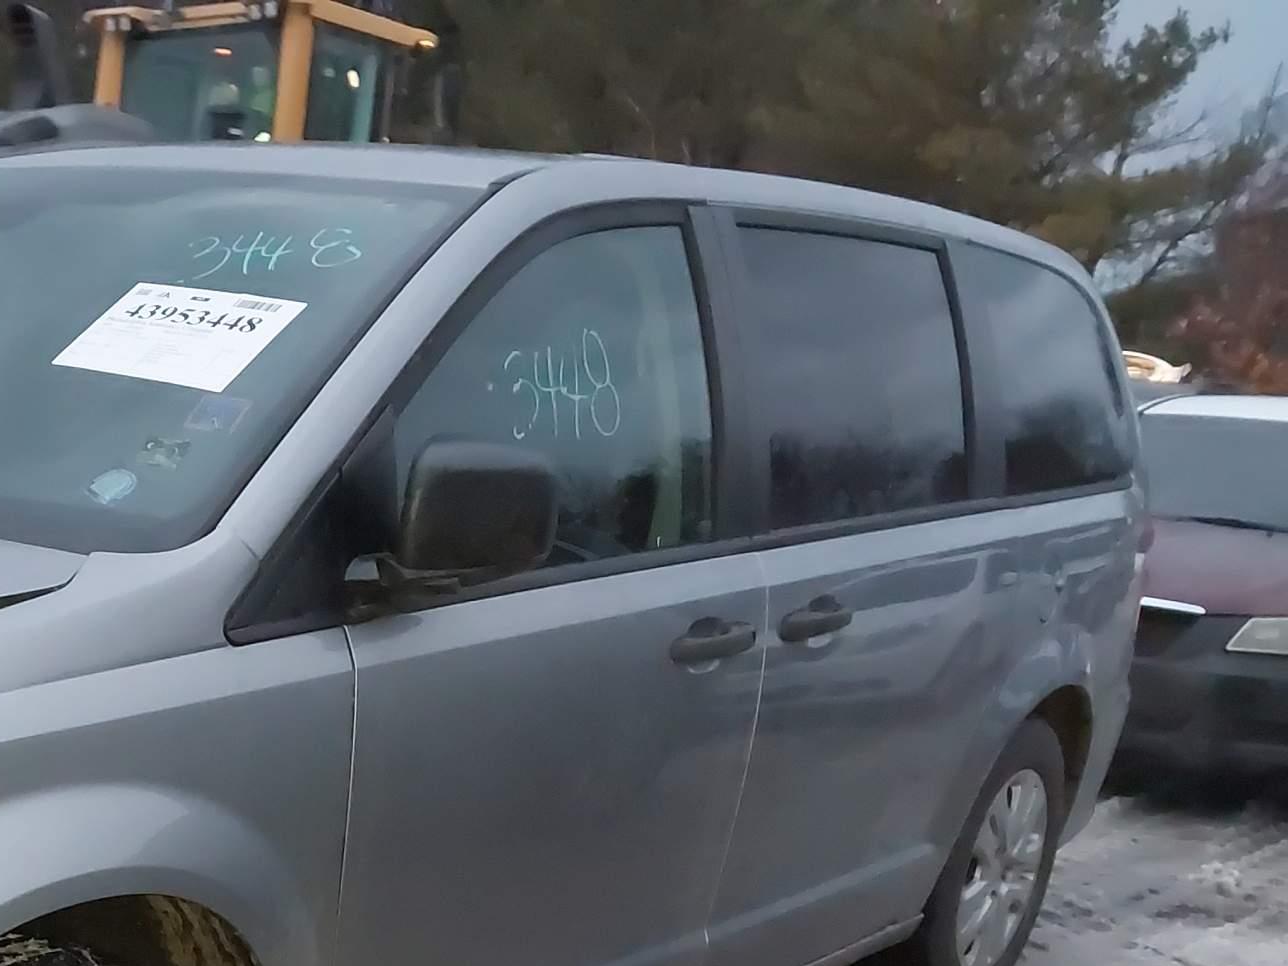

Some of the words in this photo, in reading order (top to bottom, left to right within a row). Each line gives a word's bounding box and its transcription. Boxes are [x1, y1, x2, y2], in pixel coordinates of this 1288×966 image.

[189, 227, 362, 280] 3448
[125, 302, 264, 334] 43953448
[503, 328, 621, 440] 3448
